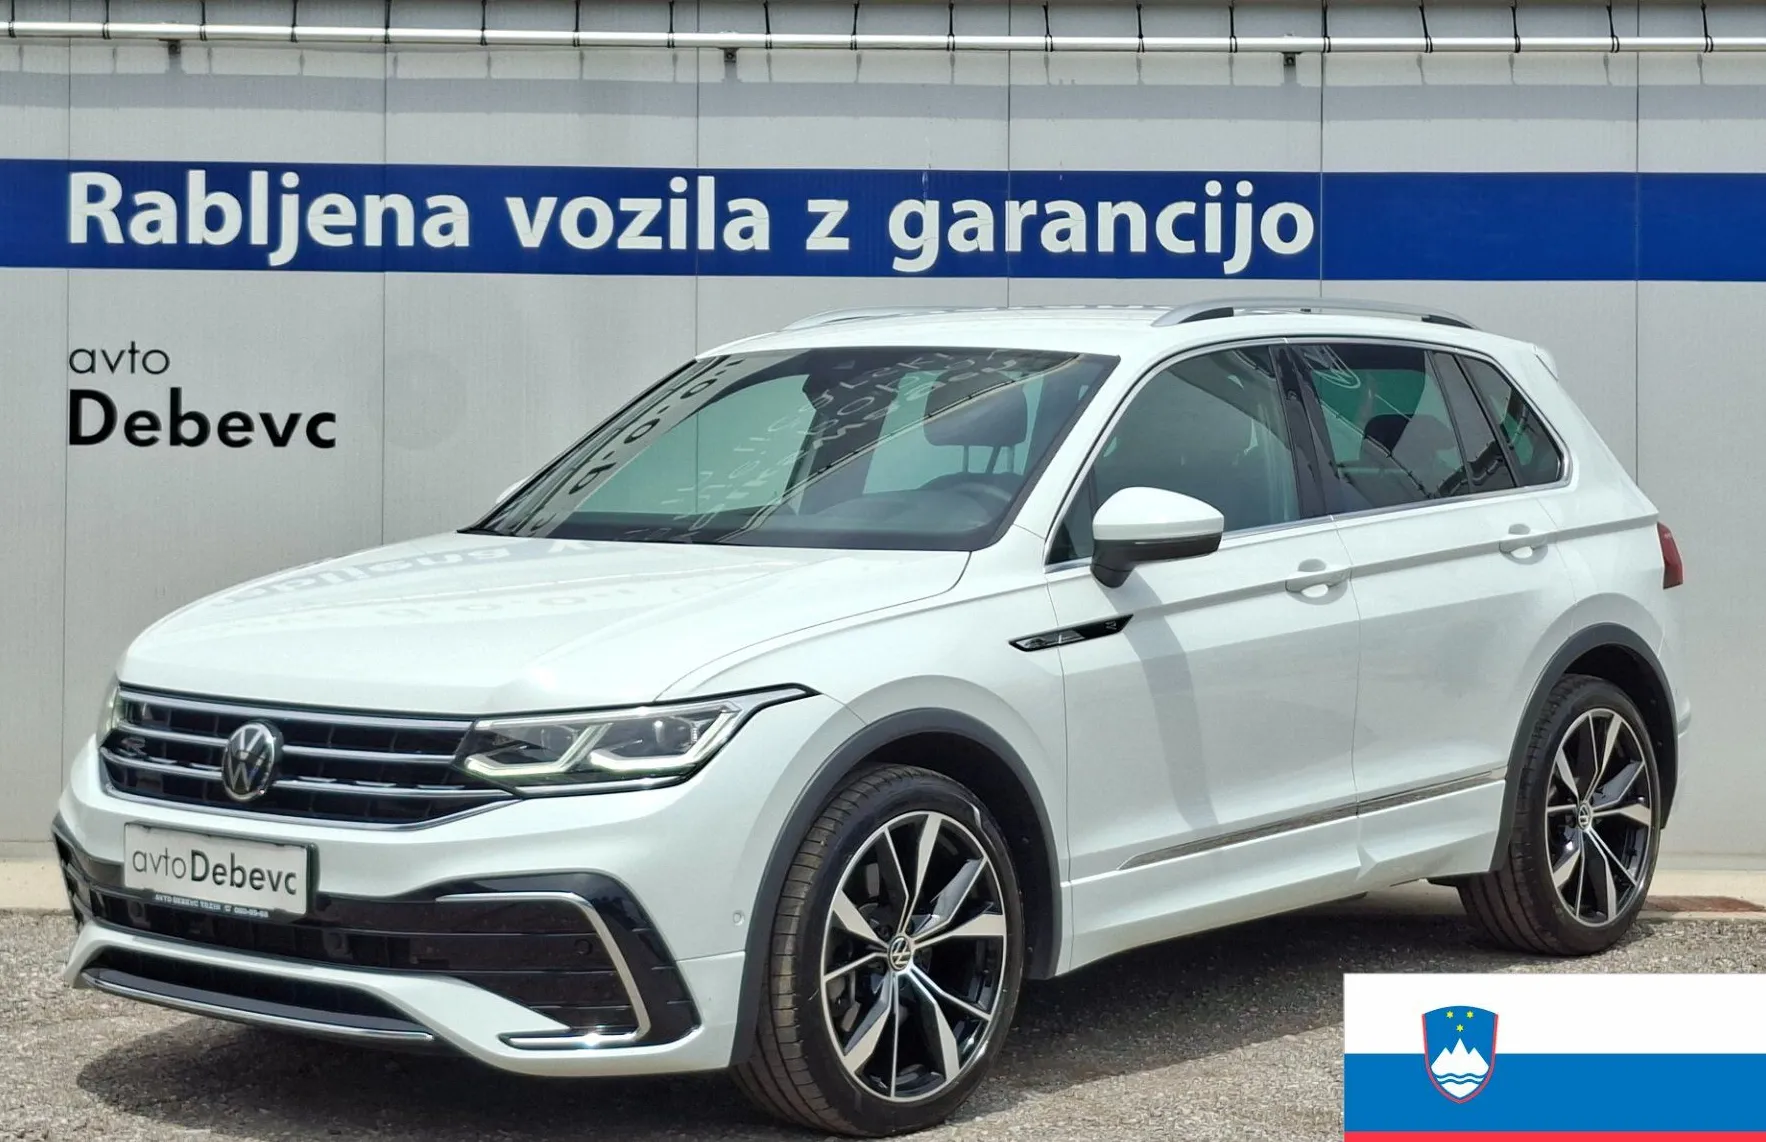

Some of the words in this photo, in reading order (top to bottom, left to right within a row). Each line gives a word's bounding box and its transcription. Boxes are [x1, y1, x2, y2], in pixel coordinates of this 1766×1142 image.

[68, 170, 470, 267] Rabljena
[505, 176, 770, 251] vozila
[806, 199, 850, 251] z
[888, 180, 1315, 275] garancijo
[69, 341, 170, 375] avto
[69, 387, 336, 449] Debevc
[132, 848, 297, 895] avtoDebevc
